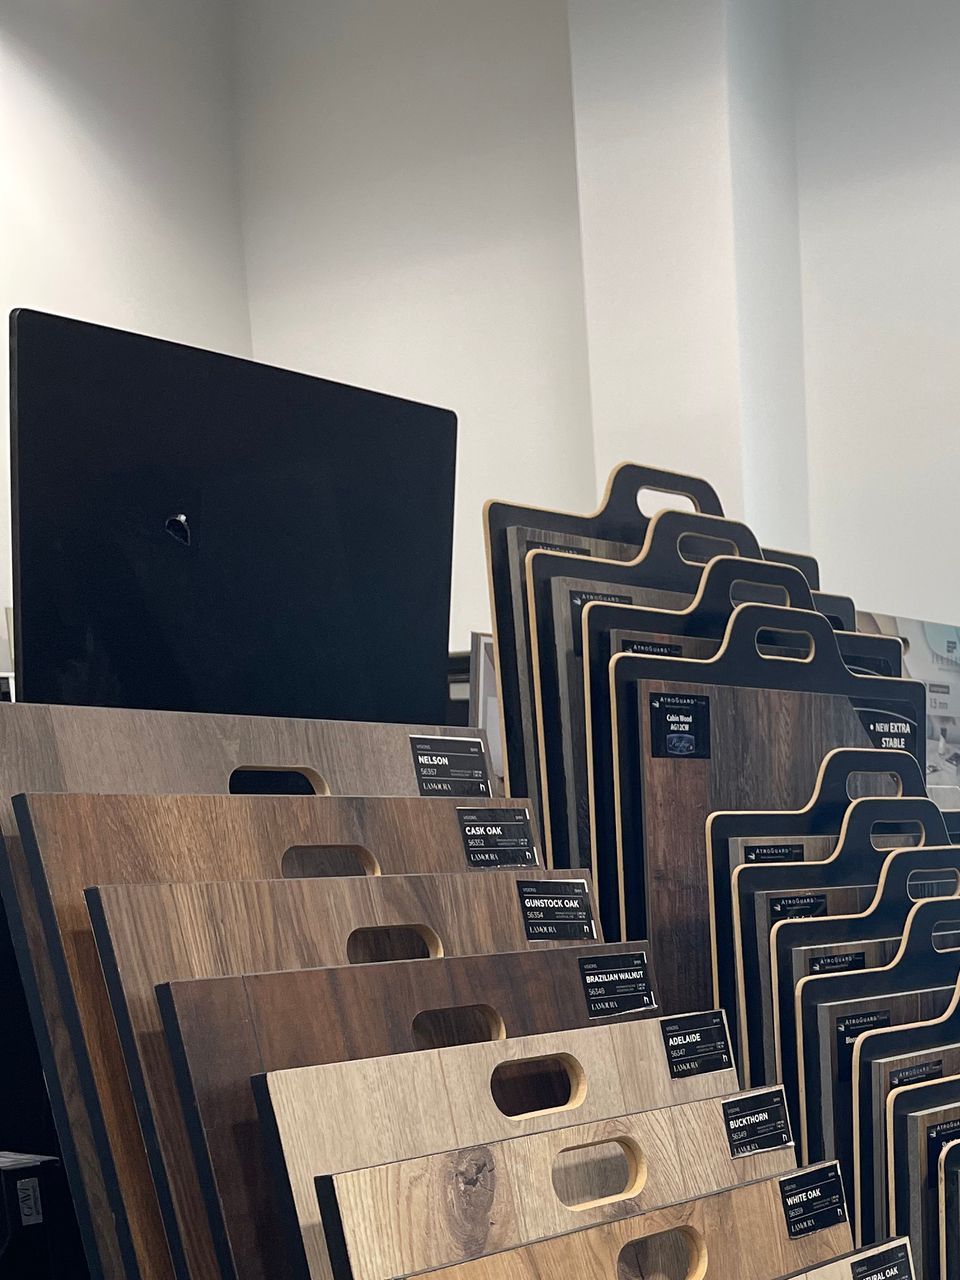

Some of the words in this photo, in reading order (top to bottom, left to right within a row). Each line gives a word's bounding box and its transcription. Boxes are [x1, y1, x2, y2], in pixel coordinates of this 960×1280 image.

[875, 722, 889, 732] NEW
[890, 722, 911, 734] EXTRA
[881, 737, 905, 748] STABLE
[418, 755, 448, 766] NELSON
[465, 826, 485, 836] CASK
[486, 826, 502, 835] OAK
[524, 898, 564, 908] GUNSTOCK
[564, 899, 580, 908] OAK
[586, 973, 619, 984] BRAZILIAN
[619, 971, 643, 981] WALNUT
[669, 1033, 702, 1046] ADELAIDE
[729, 1112, 768, 1129] BUCKTHORN
[786, 1192, 808, 1206] WHITE
[807, 1188, 821, 1199] OAK
[885, 1266, 899, 1278] OAK
